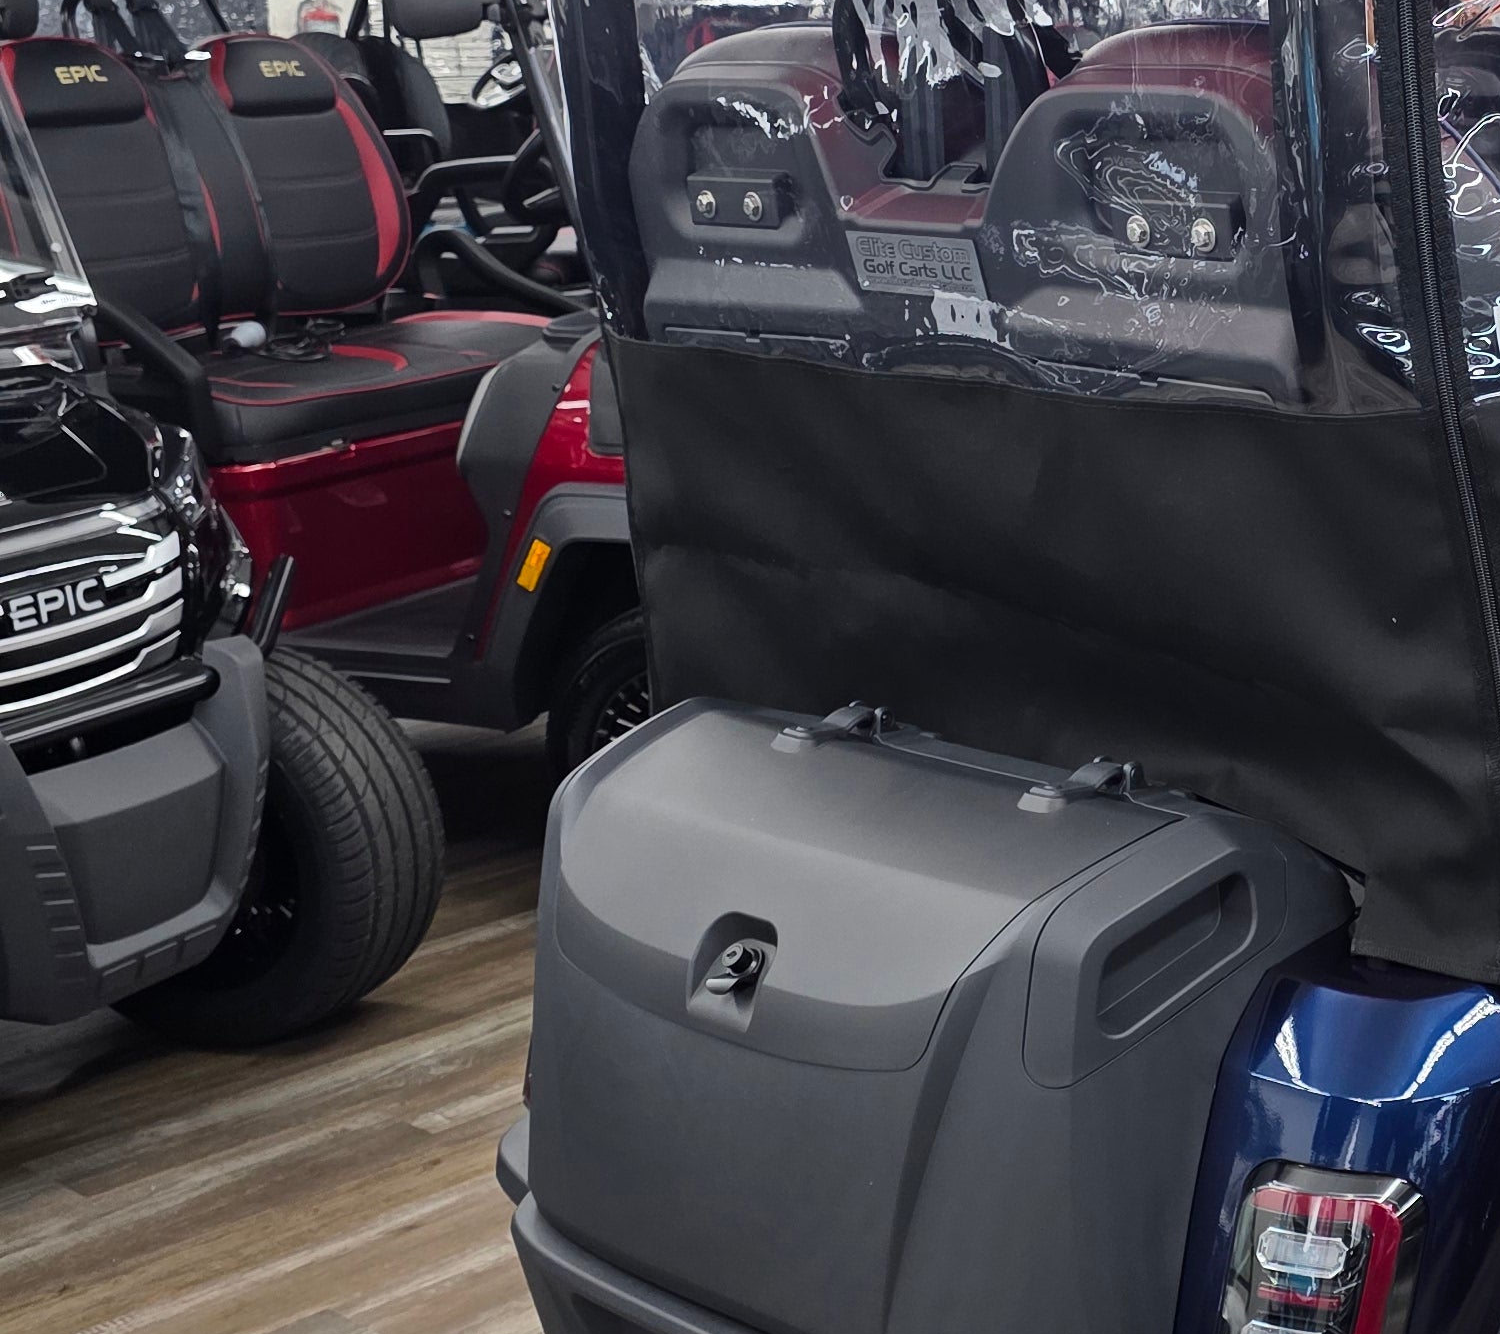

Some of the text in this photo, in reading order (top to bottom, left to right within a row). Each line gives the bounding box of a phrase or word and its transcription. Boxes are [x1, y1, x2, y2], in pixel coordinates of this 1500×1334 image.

[54, 64, 109, 85] EPIC
[258, 60, 306, 78] EPIC
[856, 236, 971, 265] Elite Custom
[863, 258, 973, 282] Golf Carts LLC
[8, 578, 105, 632] EPIC
